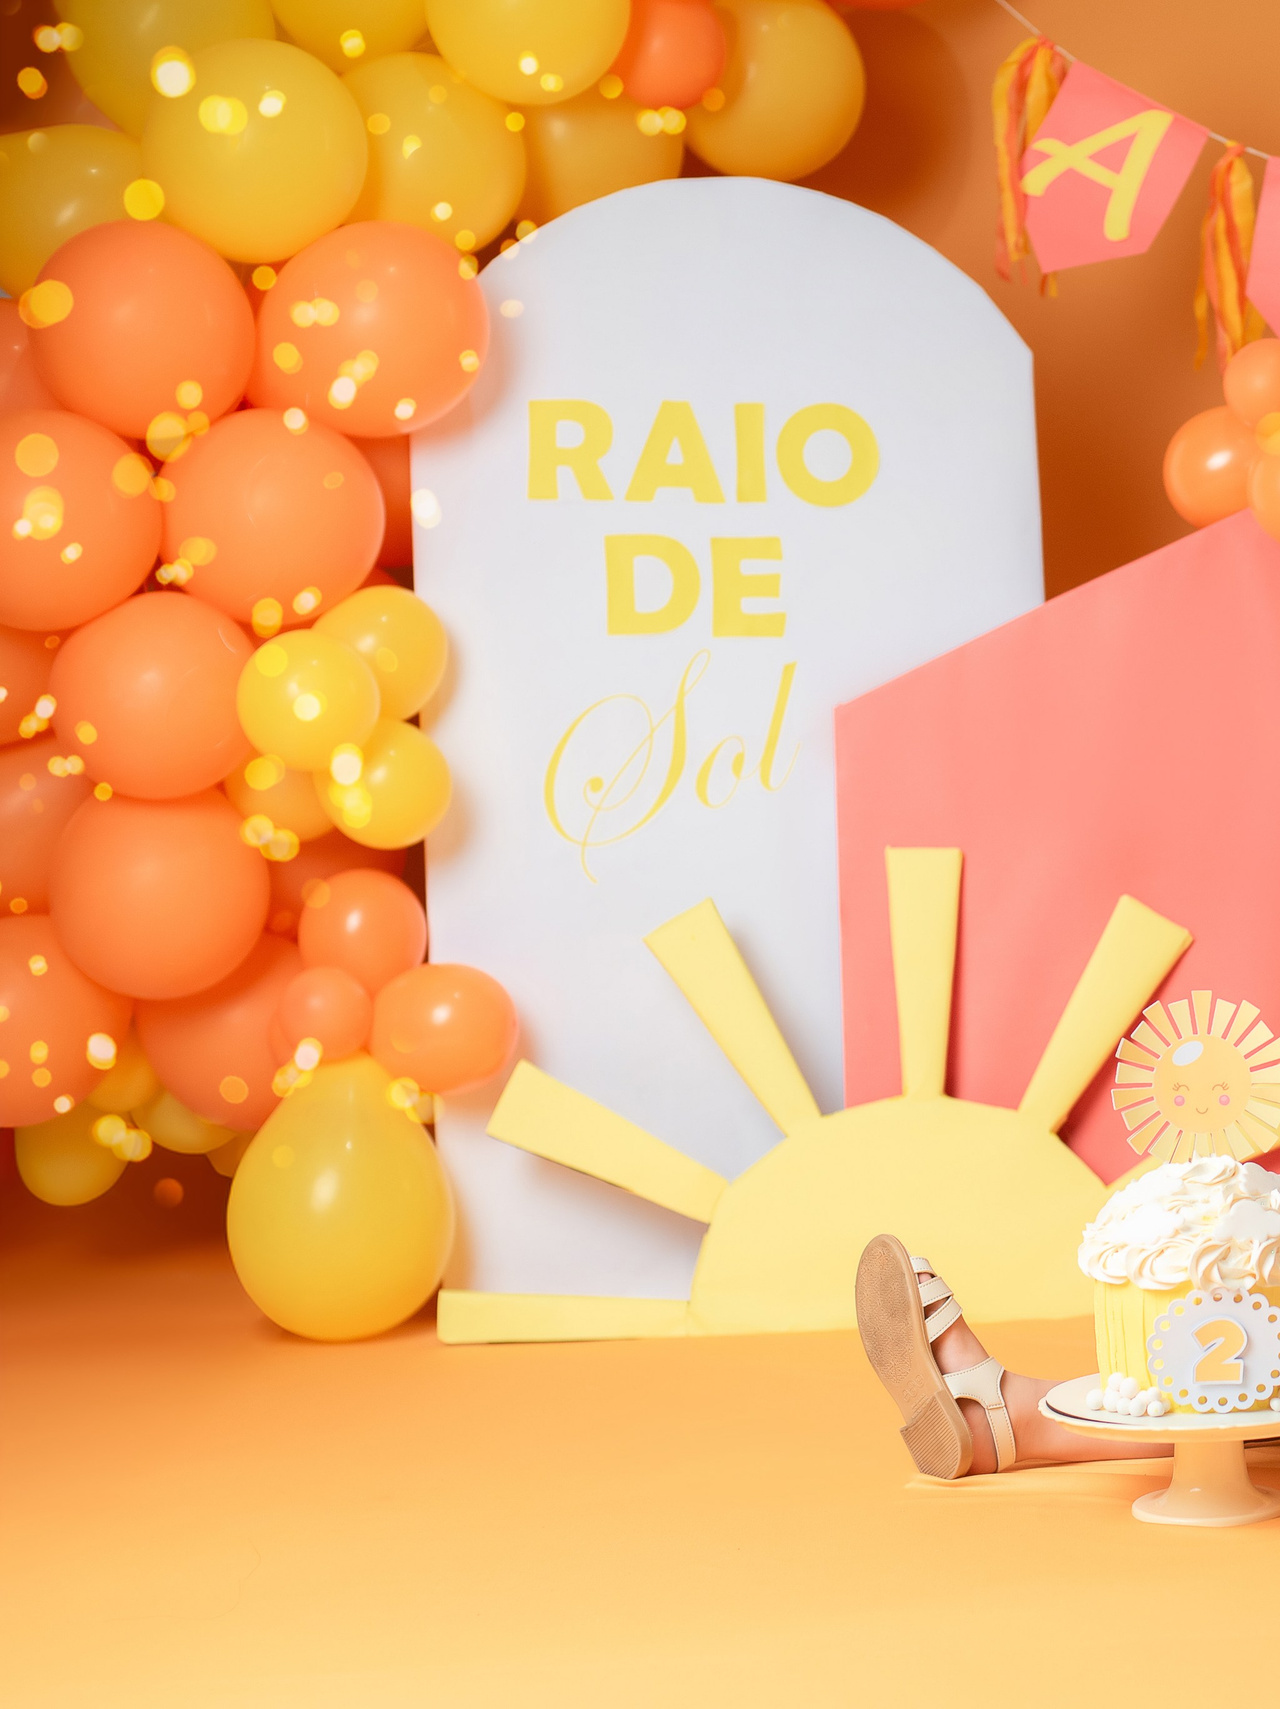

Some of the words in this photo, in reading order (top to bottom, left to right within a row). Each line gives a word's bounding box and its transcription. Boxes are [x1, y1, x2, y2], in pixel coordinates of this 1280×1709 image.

[527, 399, 880, 508] RAIO
[604, 533, 787, 638] DE
[543, 648, 801, 884] Sol
[1192, 1317, 1247, 1384] 2
